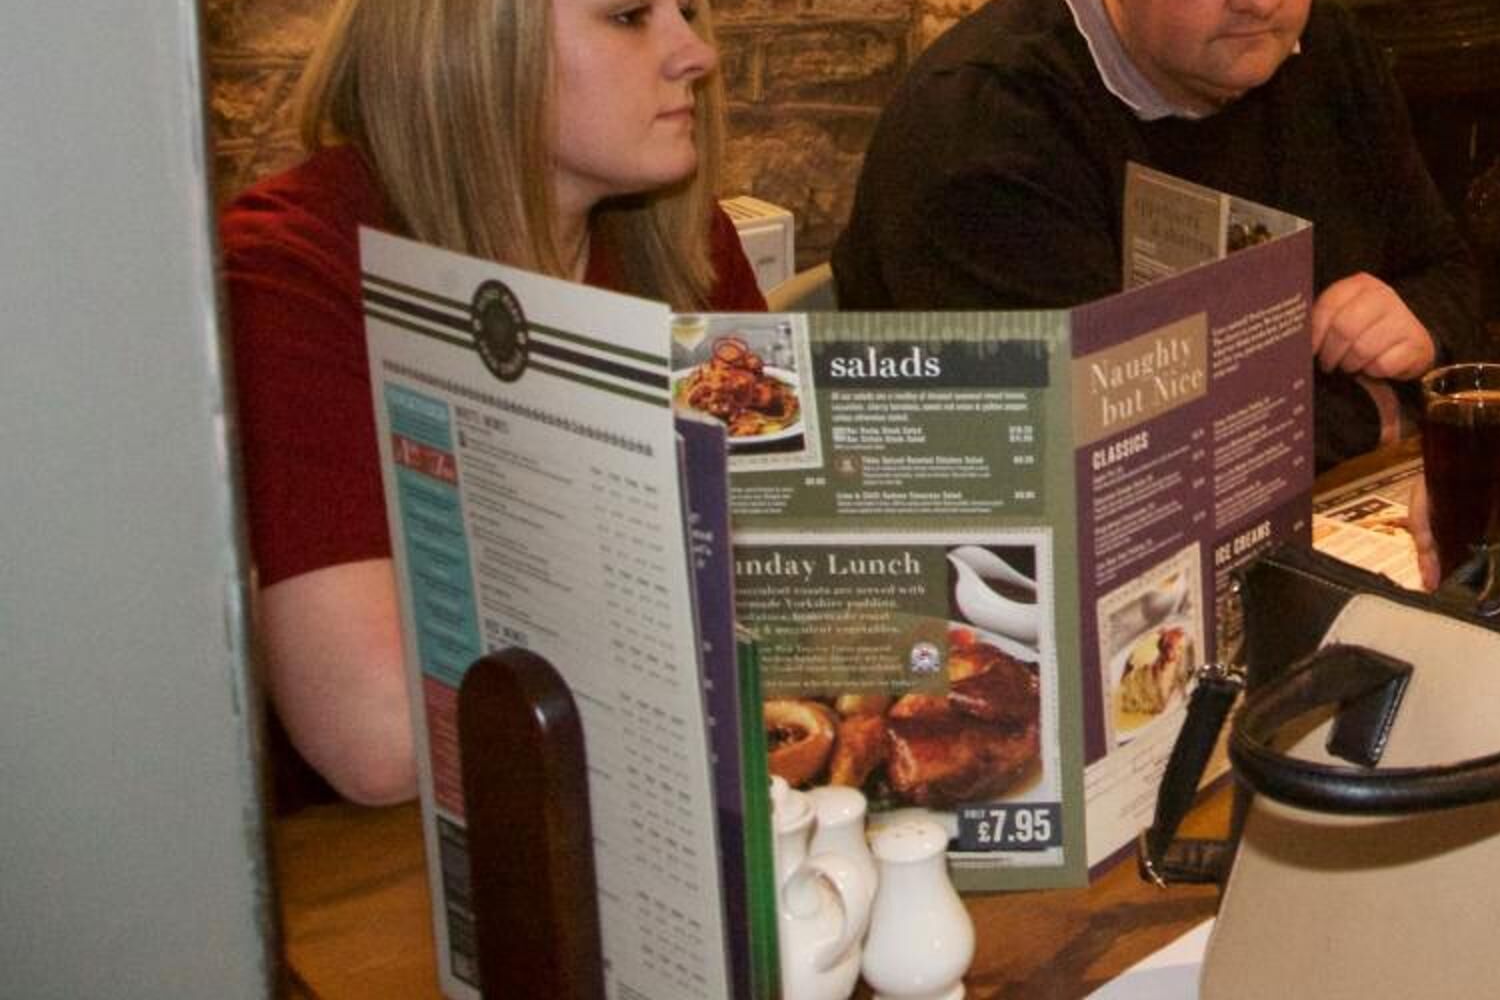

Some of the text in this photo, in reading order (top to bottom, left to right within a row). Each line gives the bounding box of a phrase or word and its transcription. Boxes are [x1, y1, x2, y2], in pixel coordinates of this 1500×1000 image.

[831, 346, 941, 378] salads
[1088, 338, 1193, 394] Naughty
[1102, 369, 1203, 427] but Nice
[1092, 430, 1150, 471] CLASSICS
[828, 552, 921, 576] Lunch
[784, 598, 844, 609] Yorkshire
[898, 585, 926, 596] with
[977, 808, 1051, 844] £7.95
